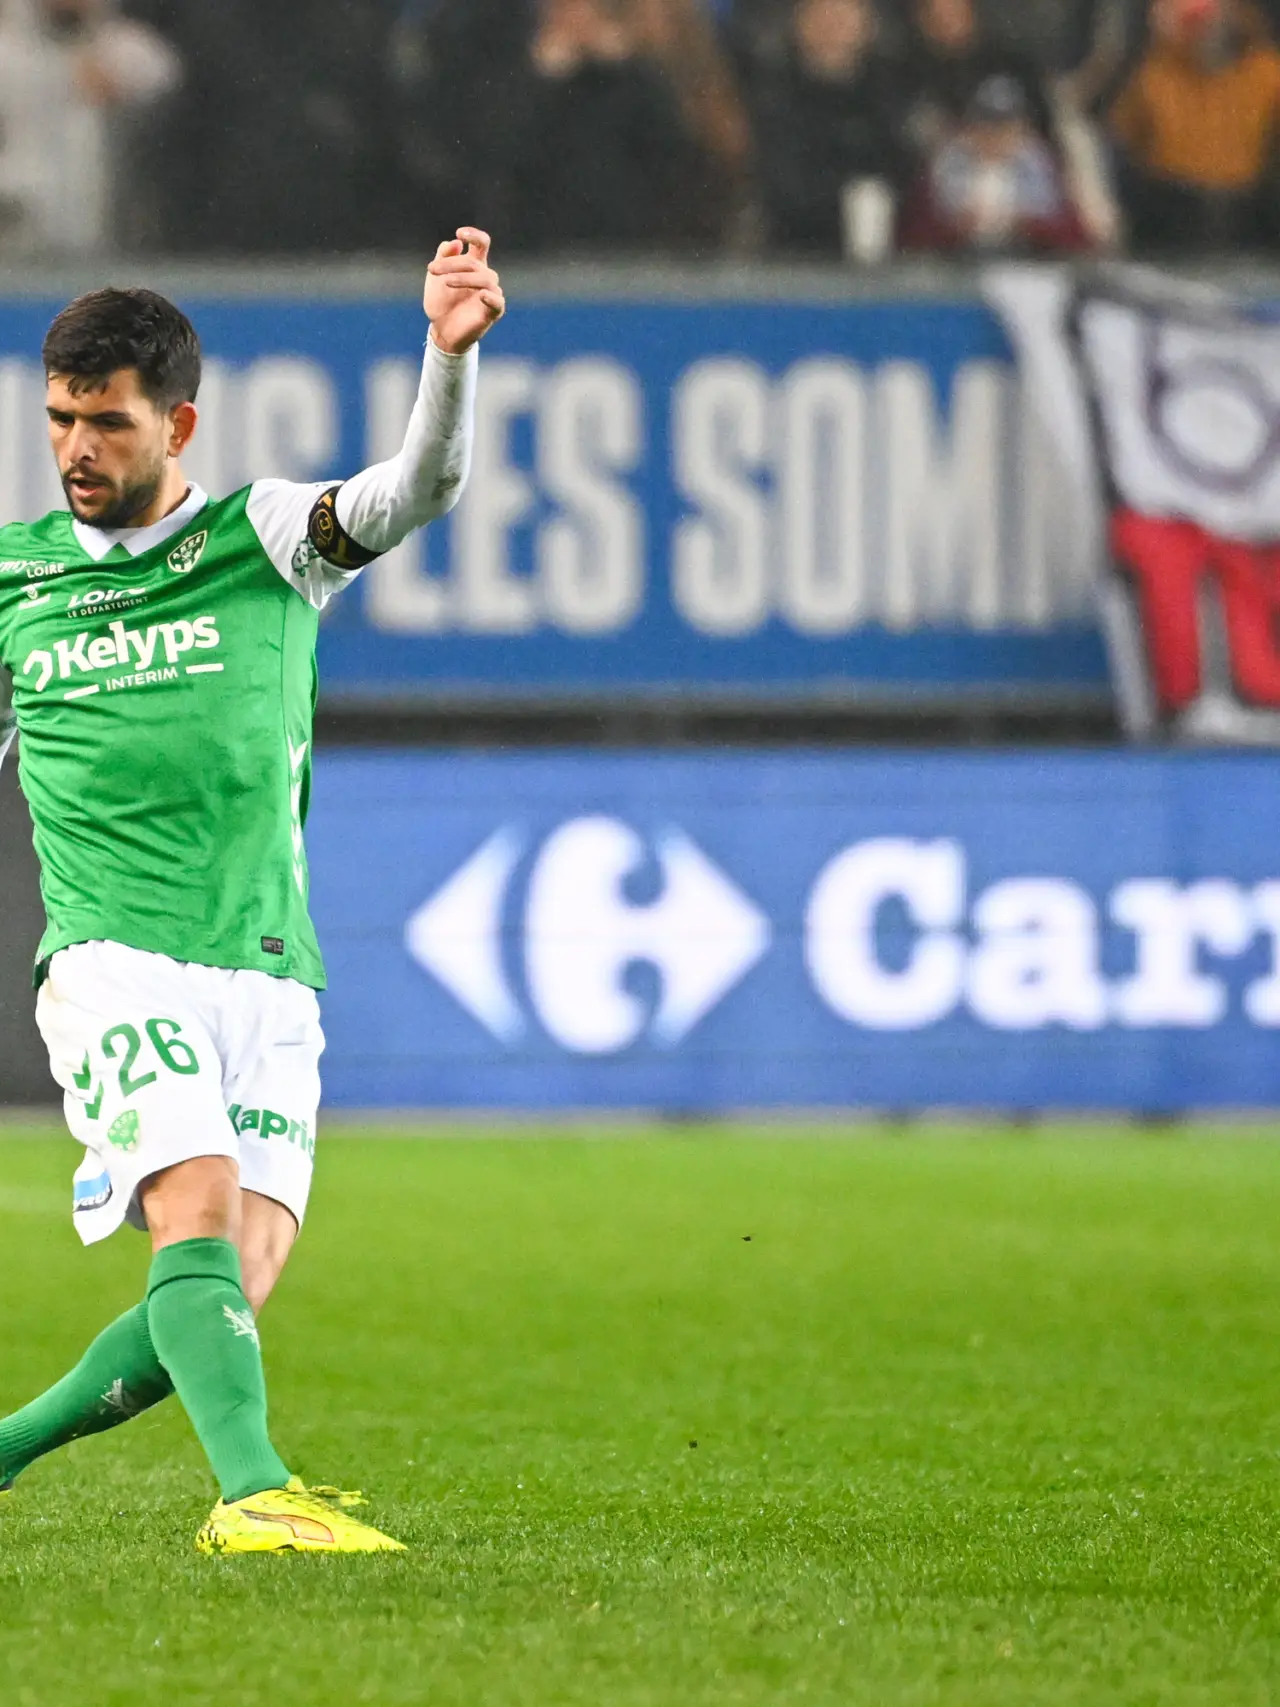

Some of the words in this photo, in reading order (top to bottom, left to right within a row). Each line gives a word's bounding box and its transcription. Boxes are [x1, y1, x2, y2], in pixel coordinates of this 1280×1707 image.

[365, 354, 644, 635] LES
[26, 562, 65, 579] LOIRE
[67, 610, 78, 619] LE
[80, 596, 149, 616] DÉPARTEMENT
[53, 615, 220, 679] Kelyps
[106, 667, 178, 691] INTERIM
[101, 1017, 200, 1097] 26
